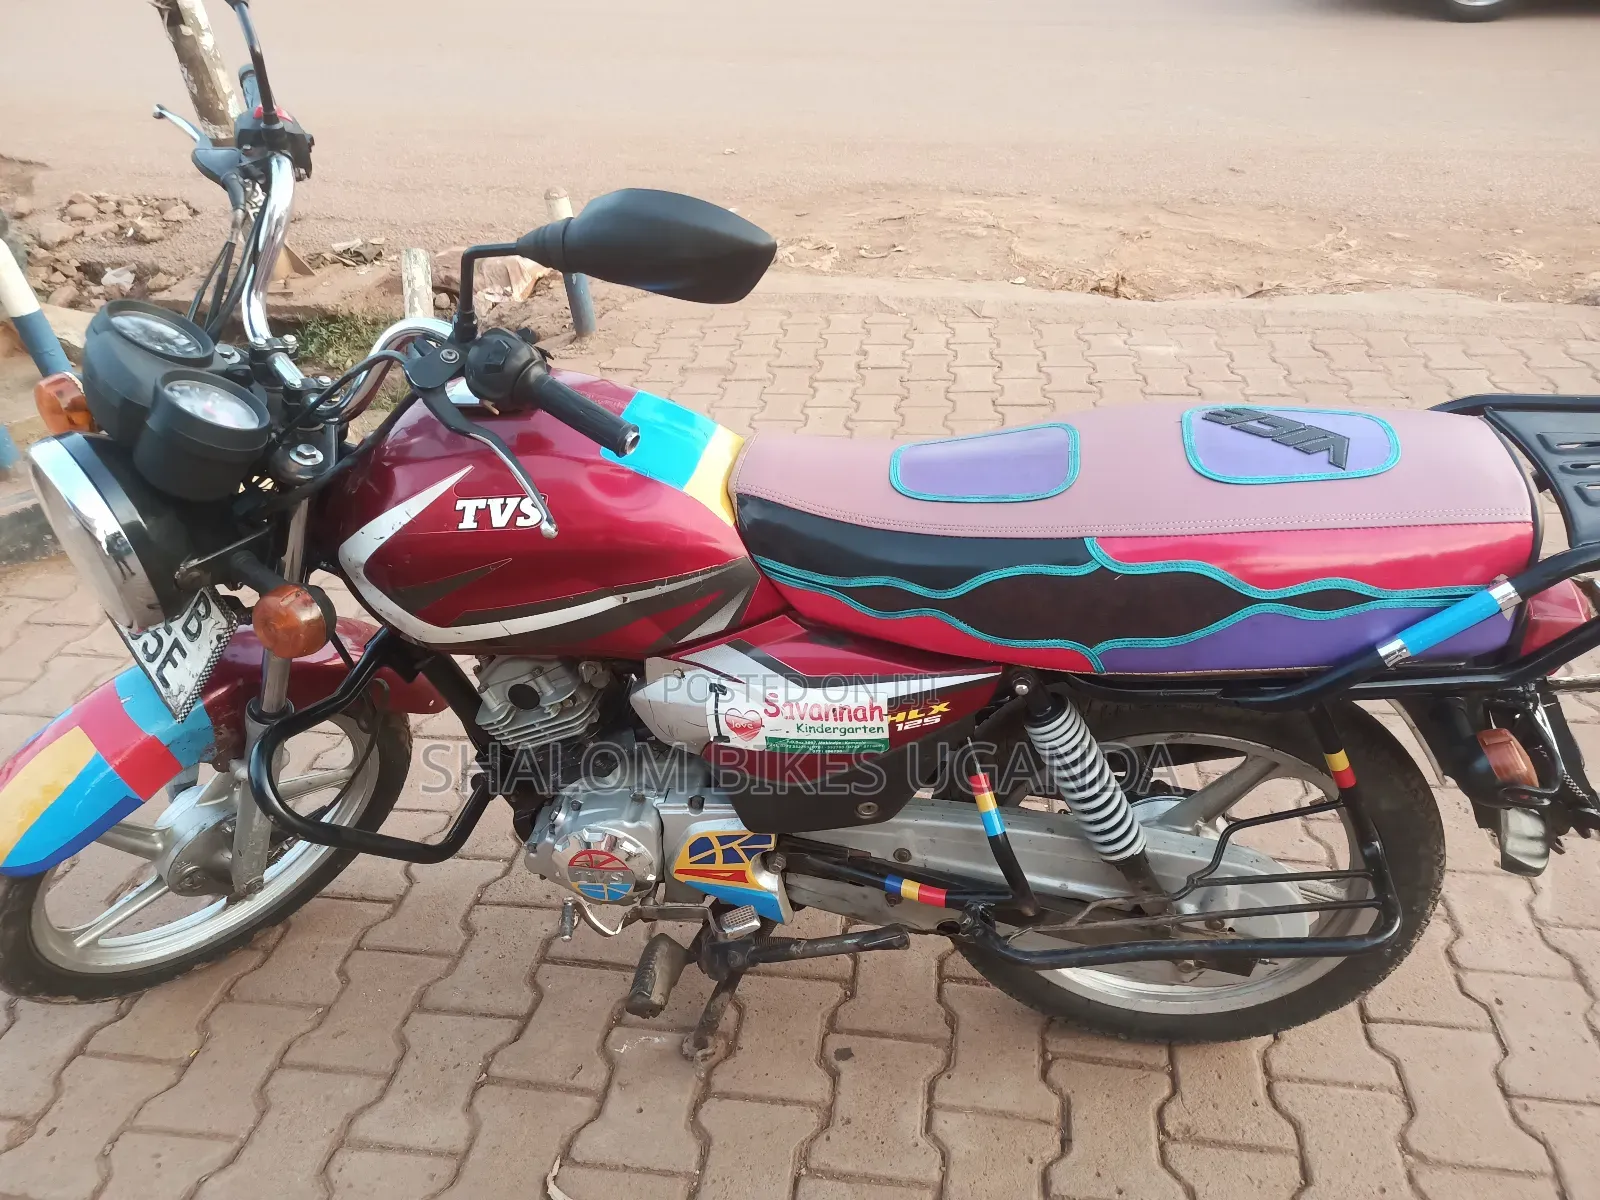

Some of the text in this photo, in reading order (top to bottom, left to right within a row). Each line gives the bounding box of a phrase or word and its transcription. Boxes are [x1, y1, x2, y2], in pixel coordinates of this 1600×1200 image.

[455, 496, 545, 531] TVS
[732, 720, 753, 729] love
[764, 693, 884, 723] Savannah
[887, 702, 951, 724] HLX
[796, 723, 885, 737] Kindergarten
[896, 714, 942, 732] 125
